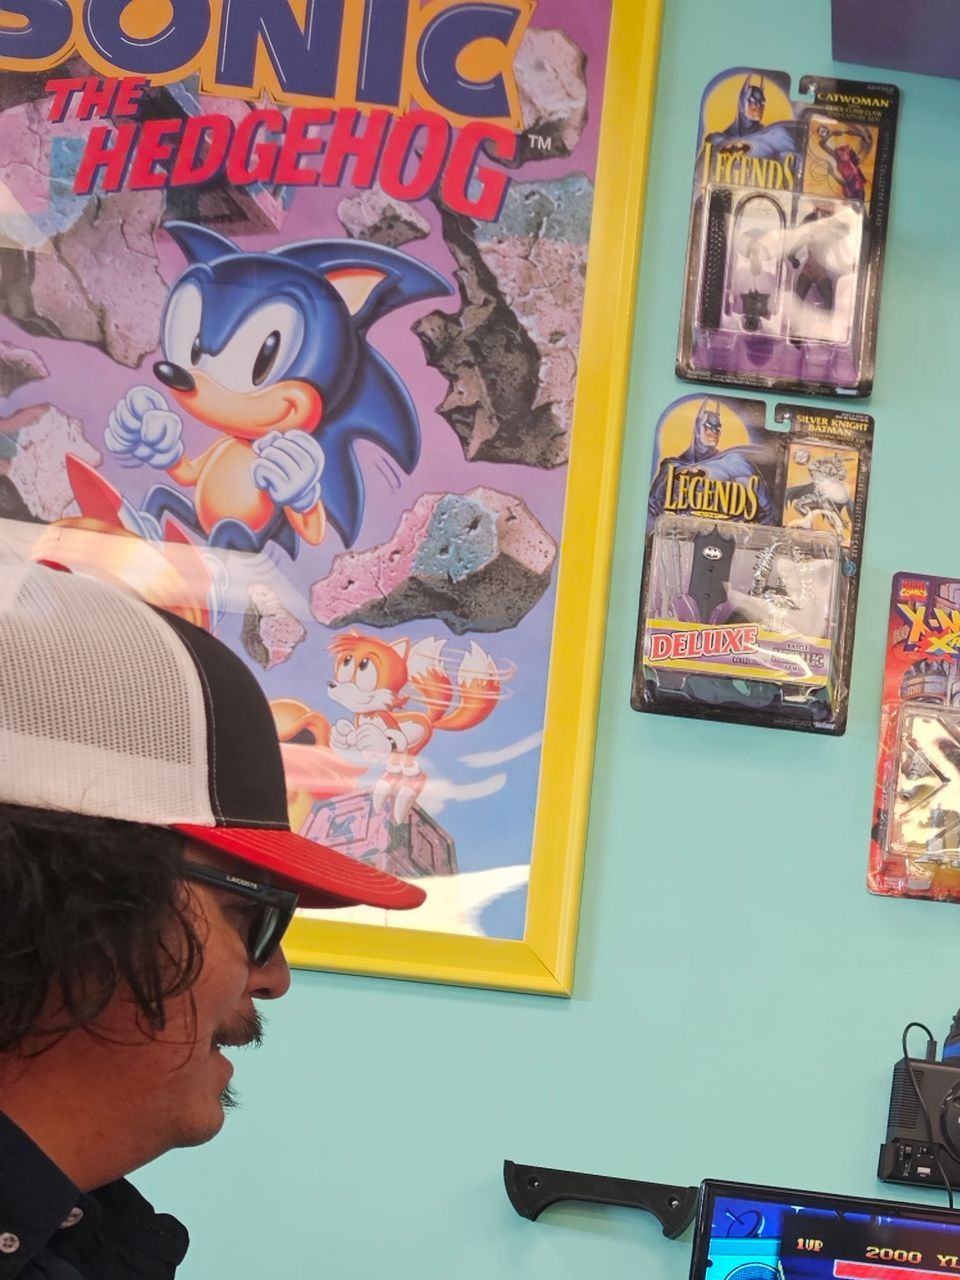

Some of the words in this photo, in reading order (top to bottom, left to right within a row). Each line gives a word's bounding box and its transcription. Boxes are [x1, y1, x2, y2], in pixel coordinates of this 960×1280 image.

[44, 76, 150, 124] THE
[817, 92, 889, 108] CATWOMAN
[73, 107, 519, 222] HEDGEHOG
[796, 414, 829, 426] SILVER
[831, 419, 869, 432] KNIGHT
[808, 424, 852, 436] BATMAN
[664, 463, 759, 520] LEGENDS
[650, 626, 759, 661] DELUXE
[796, 1238, 824, 1252] 1UP
[865, 1246, 923, 1265] 2000
